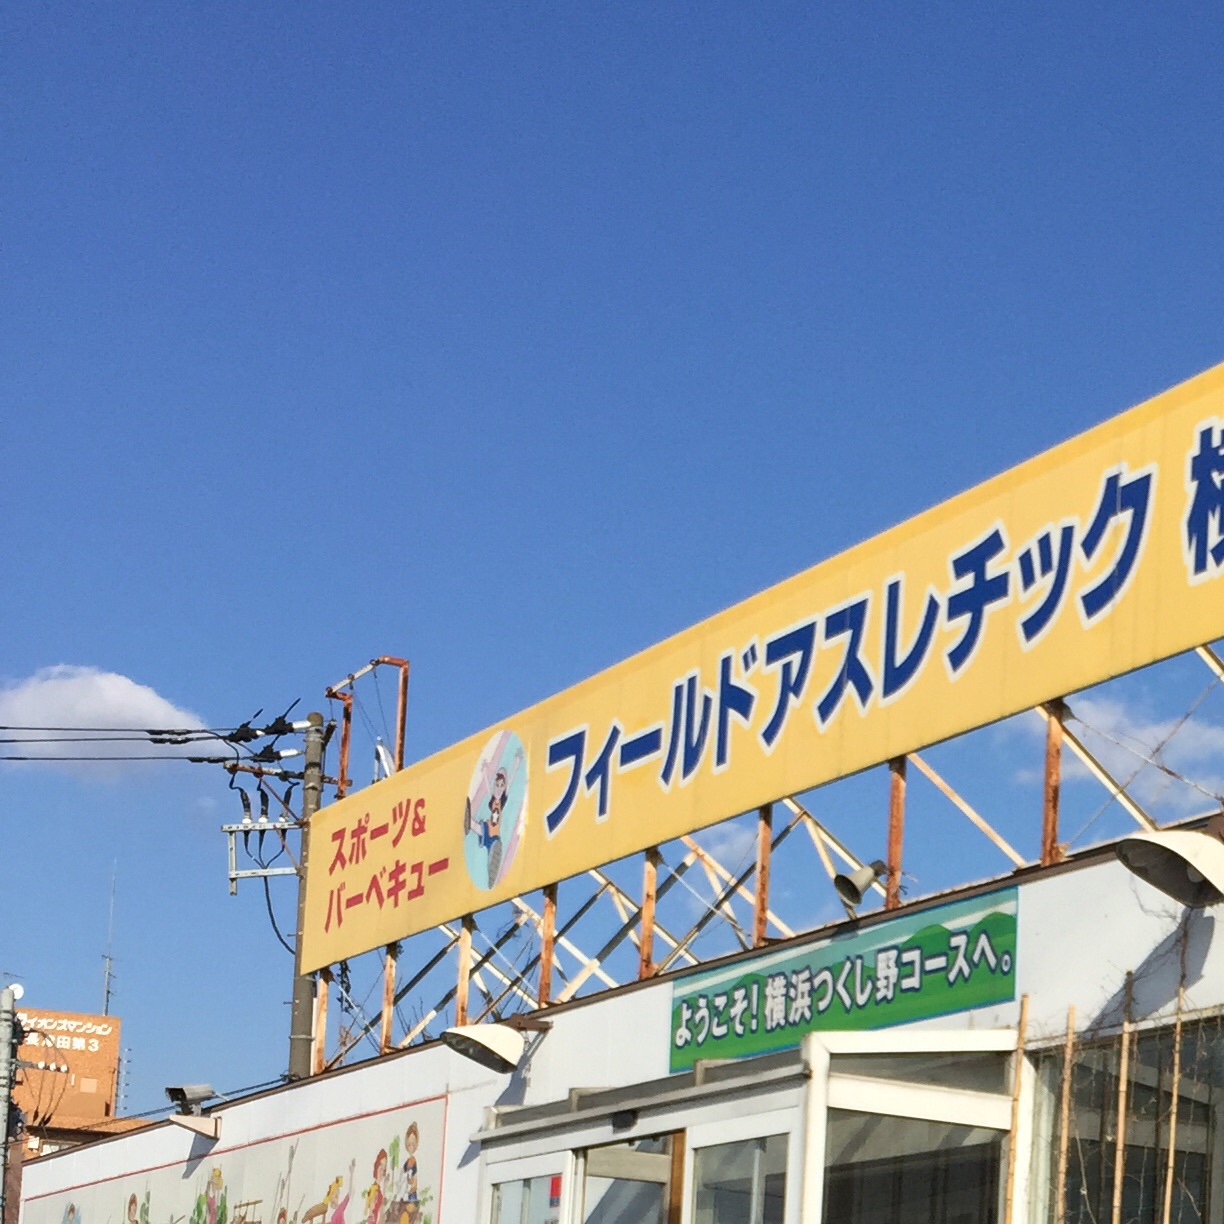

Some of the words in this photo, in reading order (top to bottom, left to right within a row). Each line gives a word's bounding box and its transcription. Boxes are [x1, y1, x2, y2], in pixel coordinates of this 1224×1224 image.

[546, 470, 1153, 834] フィールドアスレチック
[328, 797, 427, 877] スポーツ&
[323, 856, 450, 934] バーベキュー
